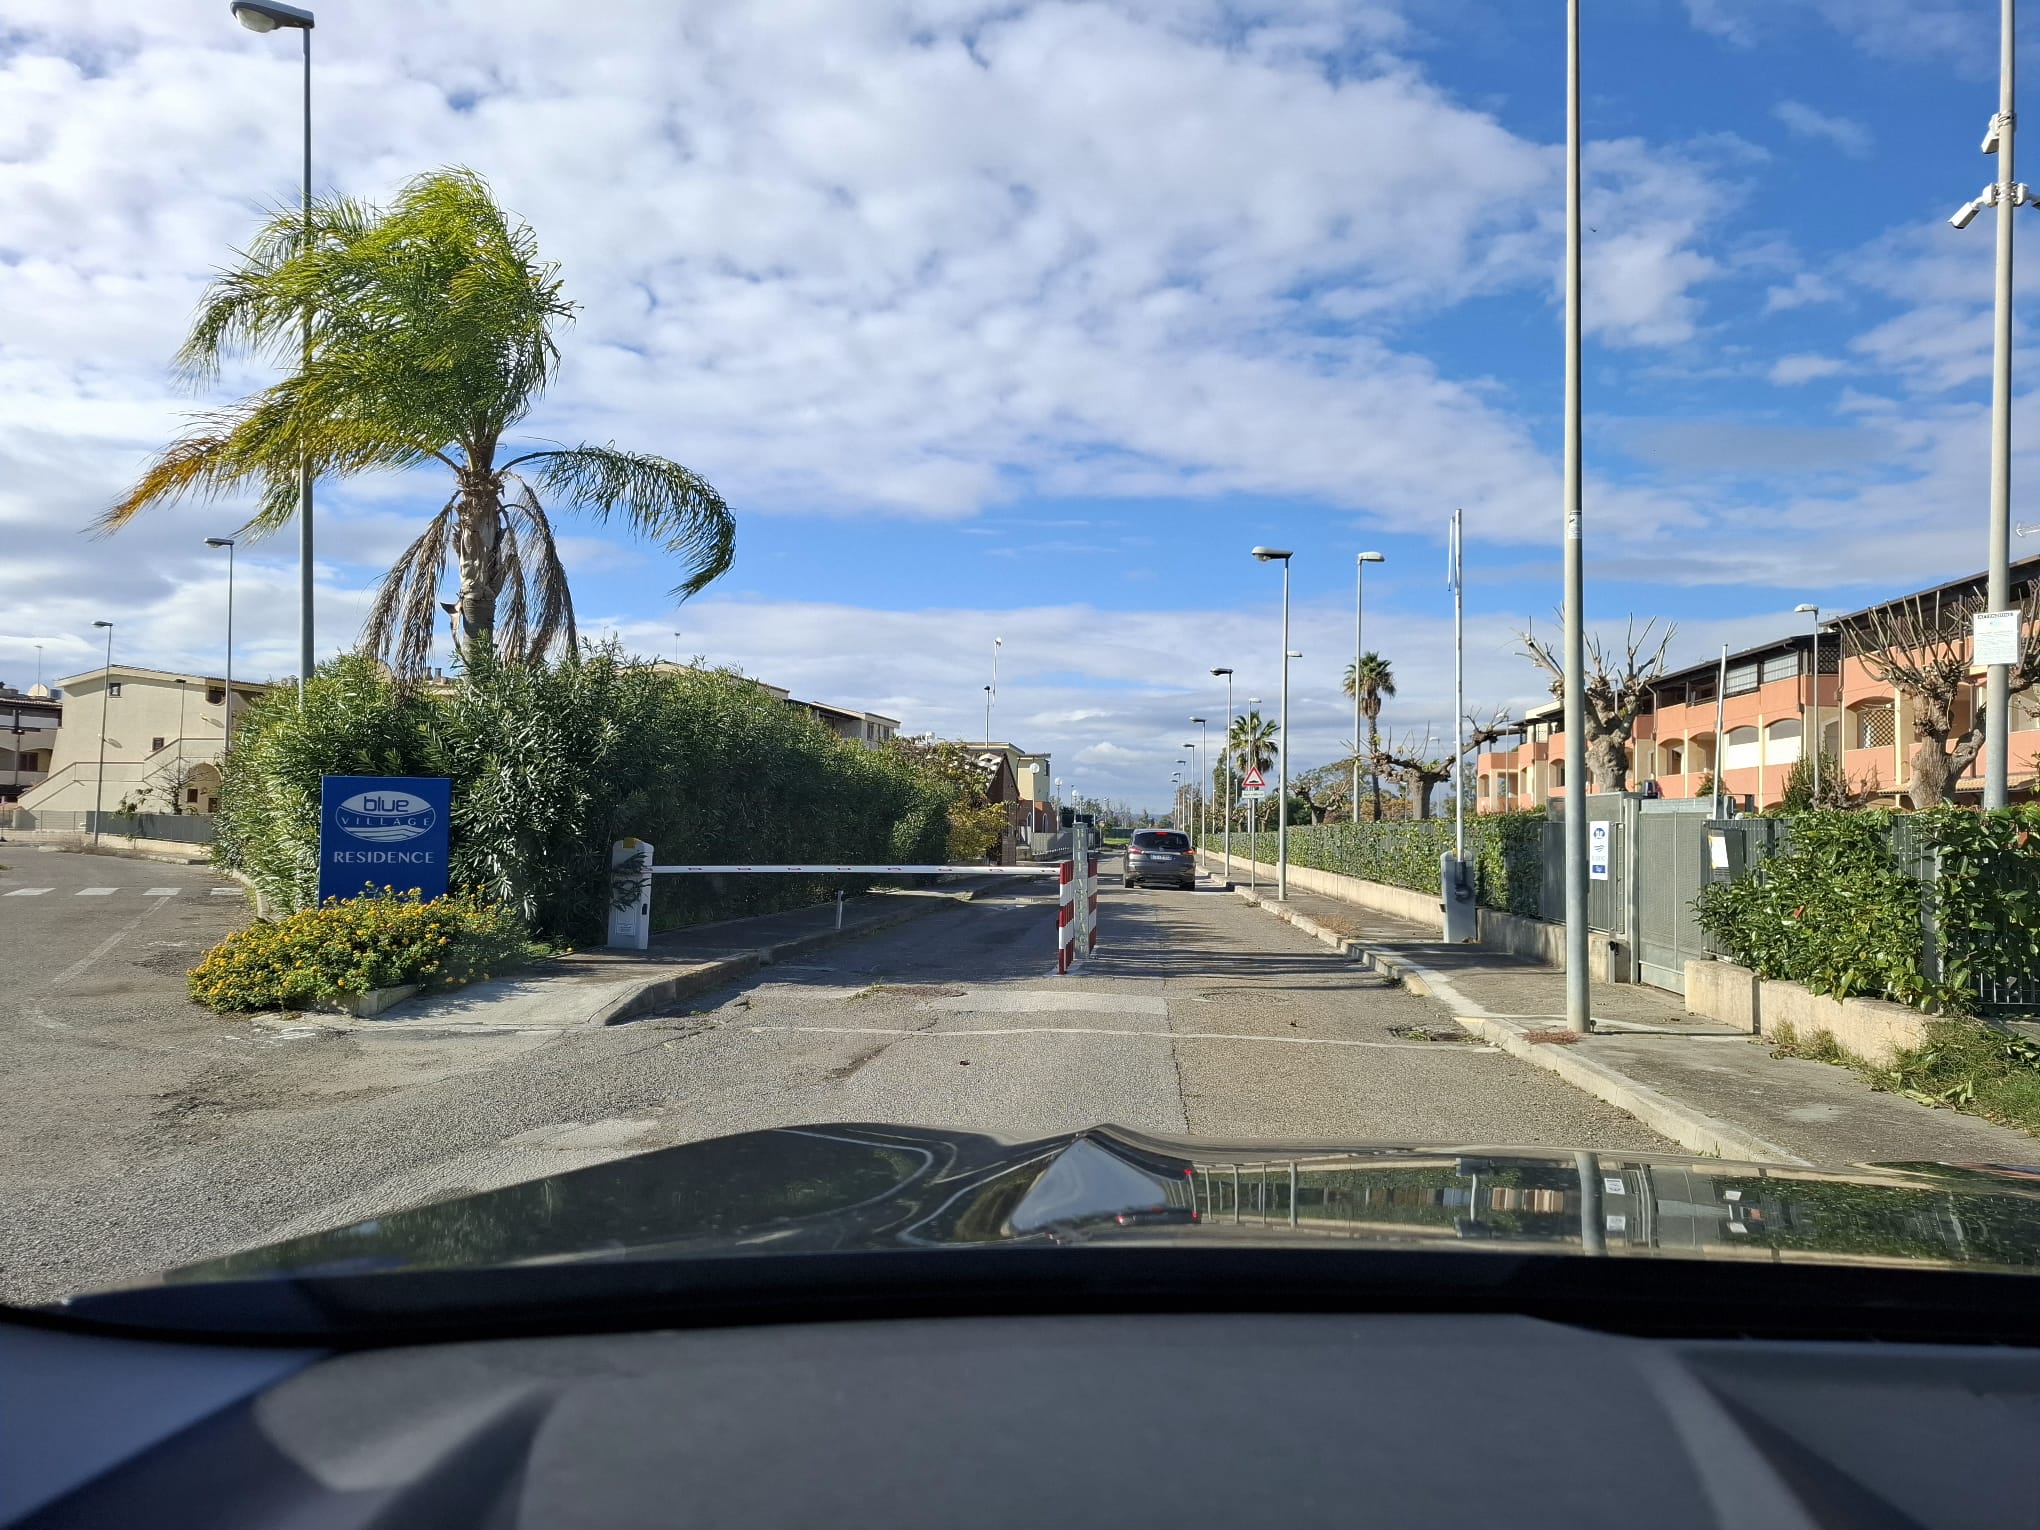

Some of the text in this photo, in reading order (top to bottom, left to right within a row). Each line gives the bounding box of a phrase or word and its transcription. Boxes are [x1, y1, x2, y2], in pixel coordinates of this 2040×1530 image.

[363, 796, 410, 812] blue
[341, 816, 431, 826] VILLAGE
[333, 851, 435, 864] RESIDENCE
